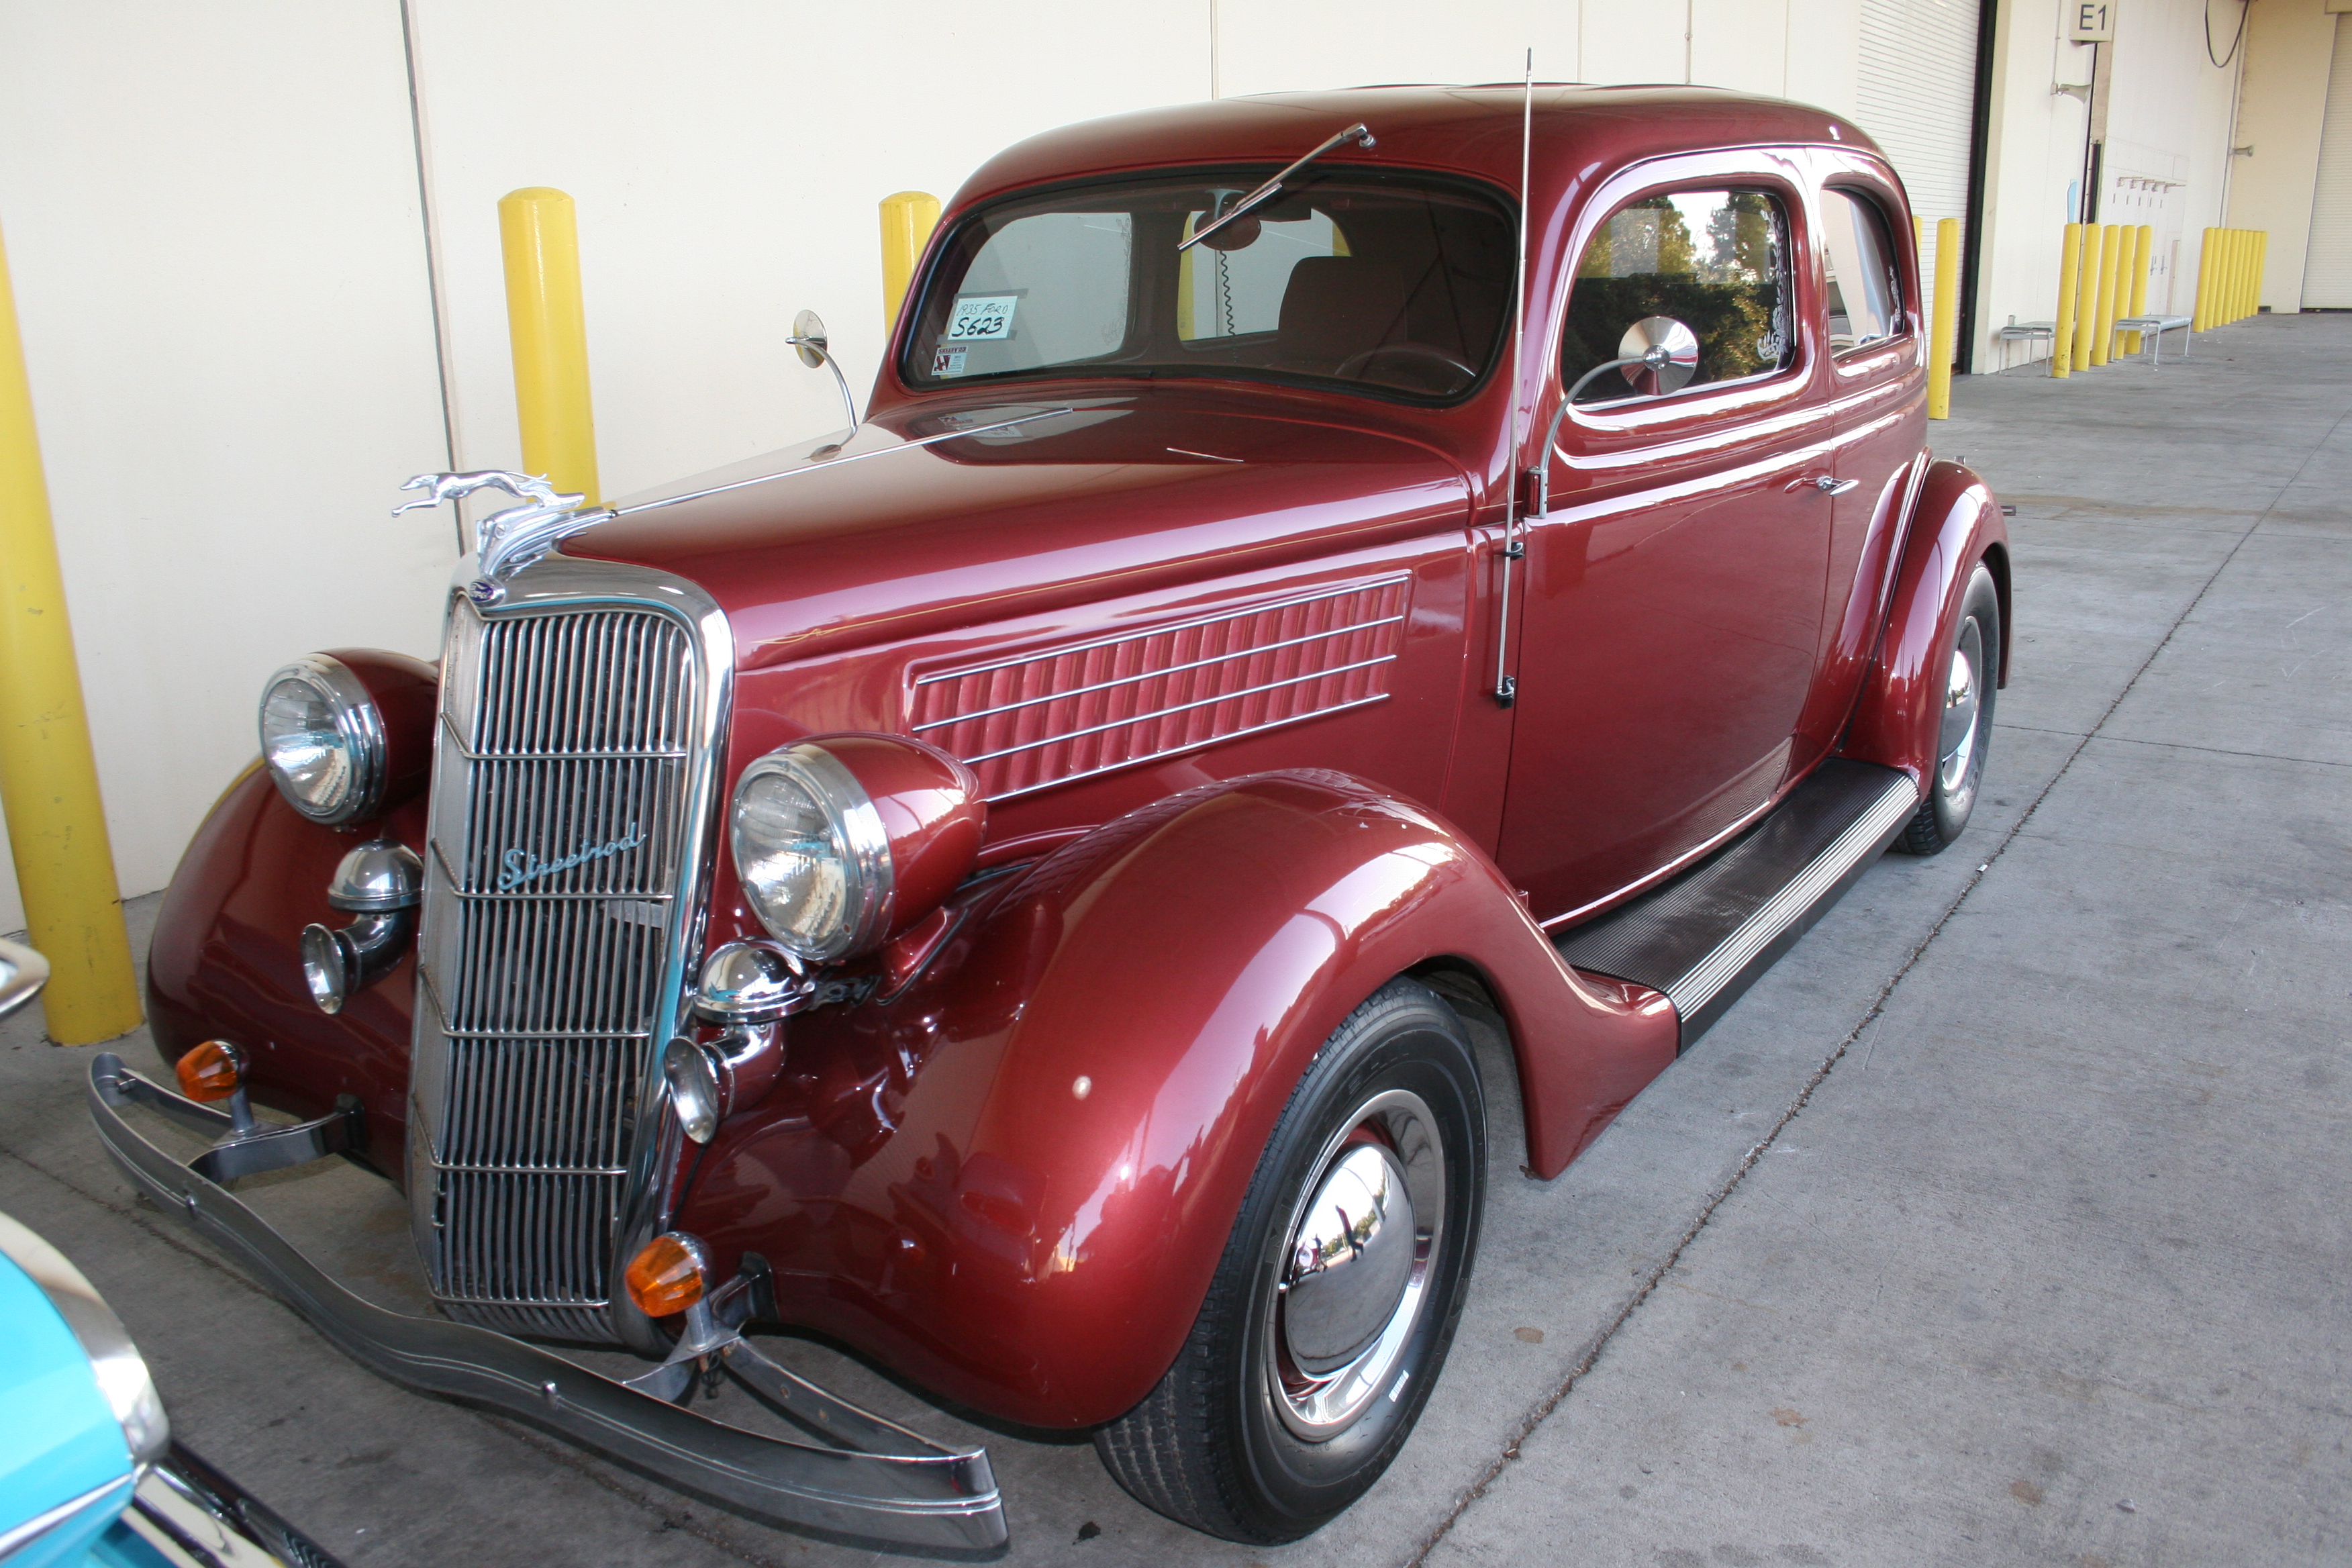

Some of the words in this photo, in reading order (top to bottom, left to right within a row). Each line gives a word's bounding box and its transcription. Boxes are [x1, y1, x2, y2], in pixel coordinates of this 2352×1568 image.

[2079, 4, 2106, 31] E1
[956, 304, 981, 316] 1935
[980, 303, 1008, 315] FORD
[497, 822, 648, 890] Streetrod
